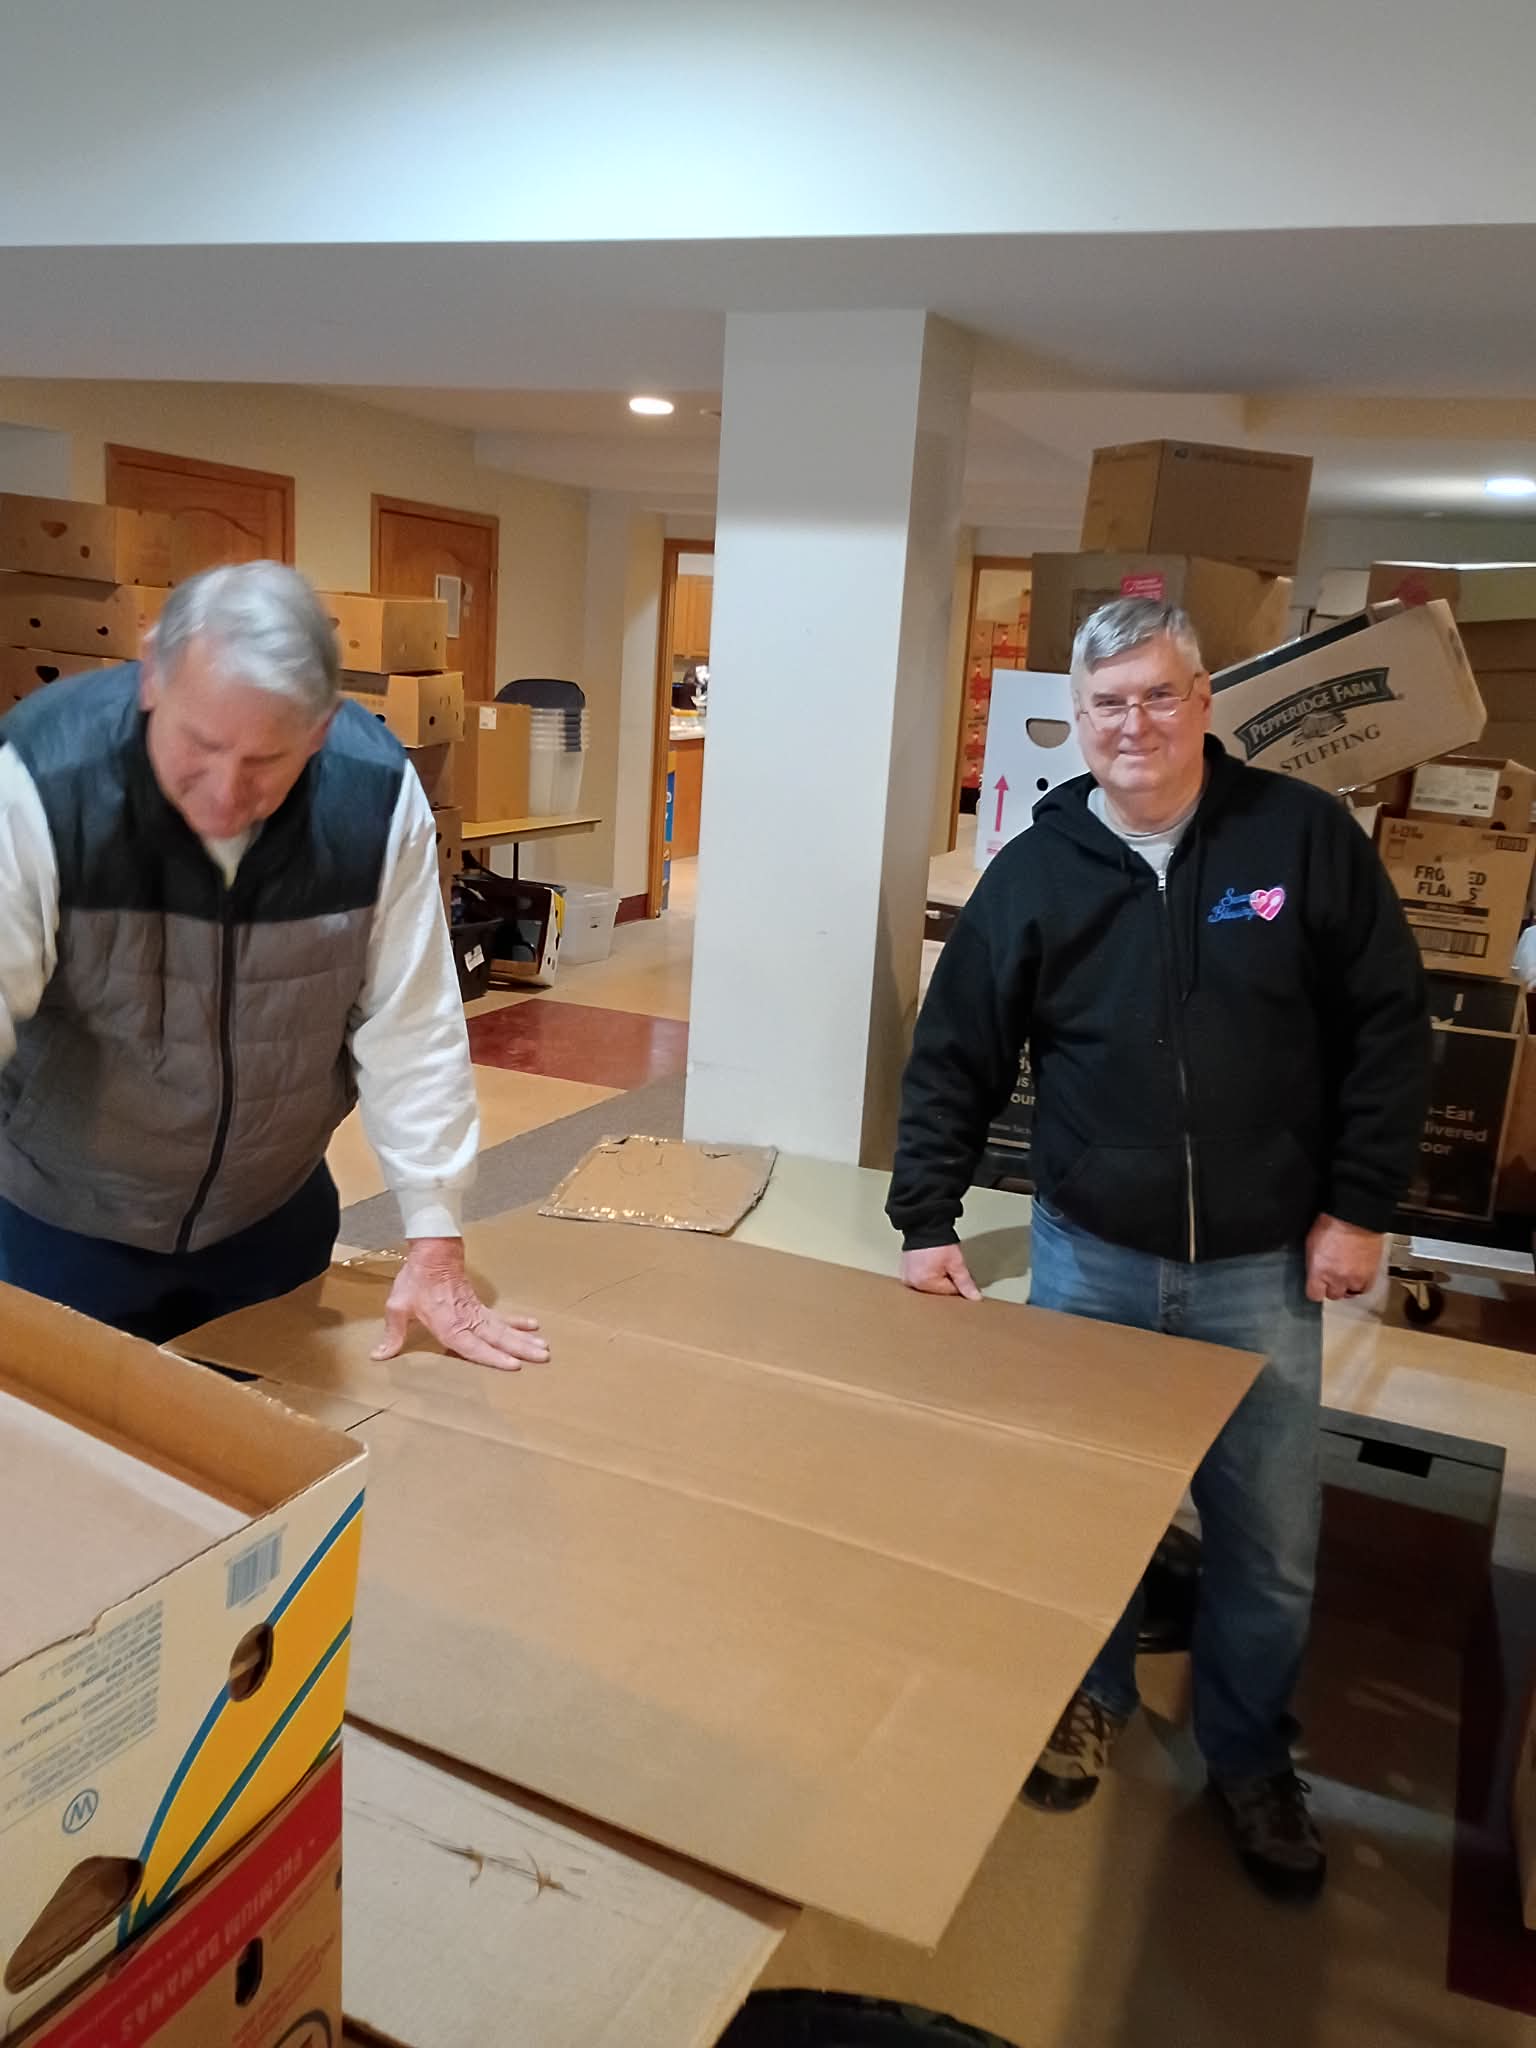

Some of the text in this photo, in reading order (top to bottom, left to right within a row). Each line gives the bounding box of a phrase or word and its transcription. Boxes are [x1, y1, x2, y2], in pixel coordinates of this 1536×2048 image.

[1250, 680, 1377, 744] PEPPERIDGE FARM
[1280, 723, 1381, 773] STUFFING
[1010, 1092, 1036, 1106] our
[1423, 1120, 1488, 1142] livered
[1419, 1142, 1453, 1156] oor
